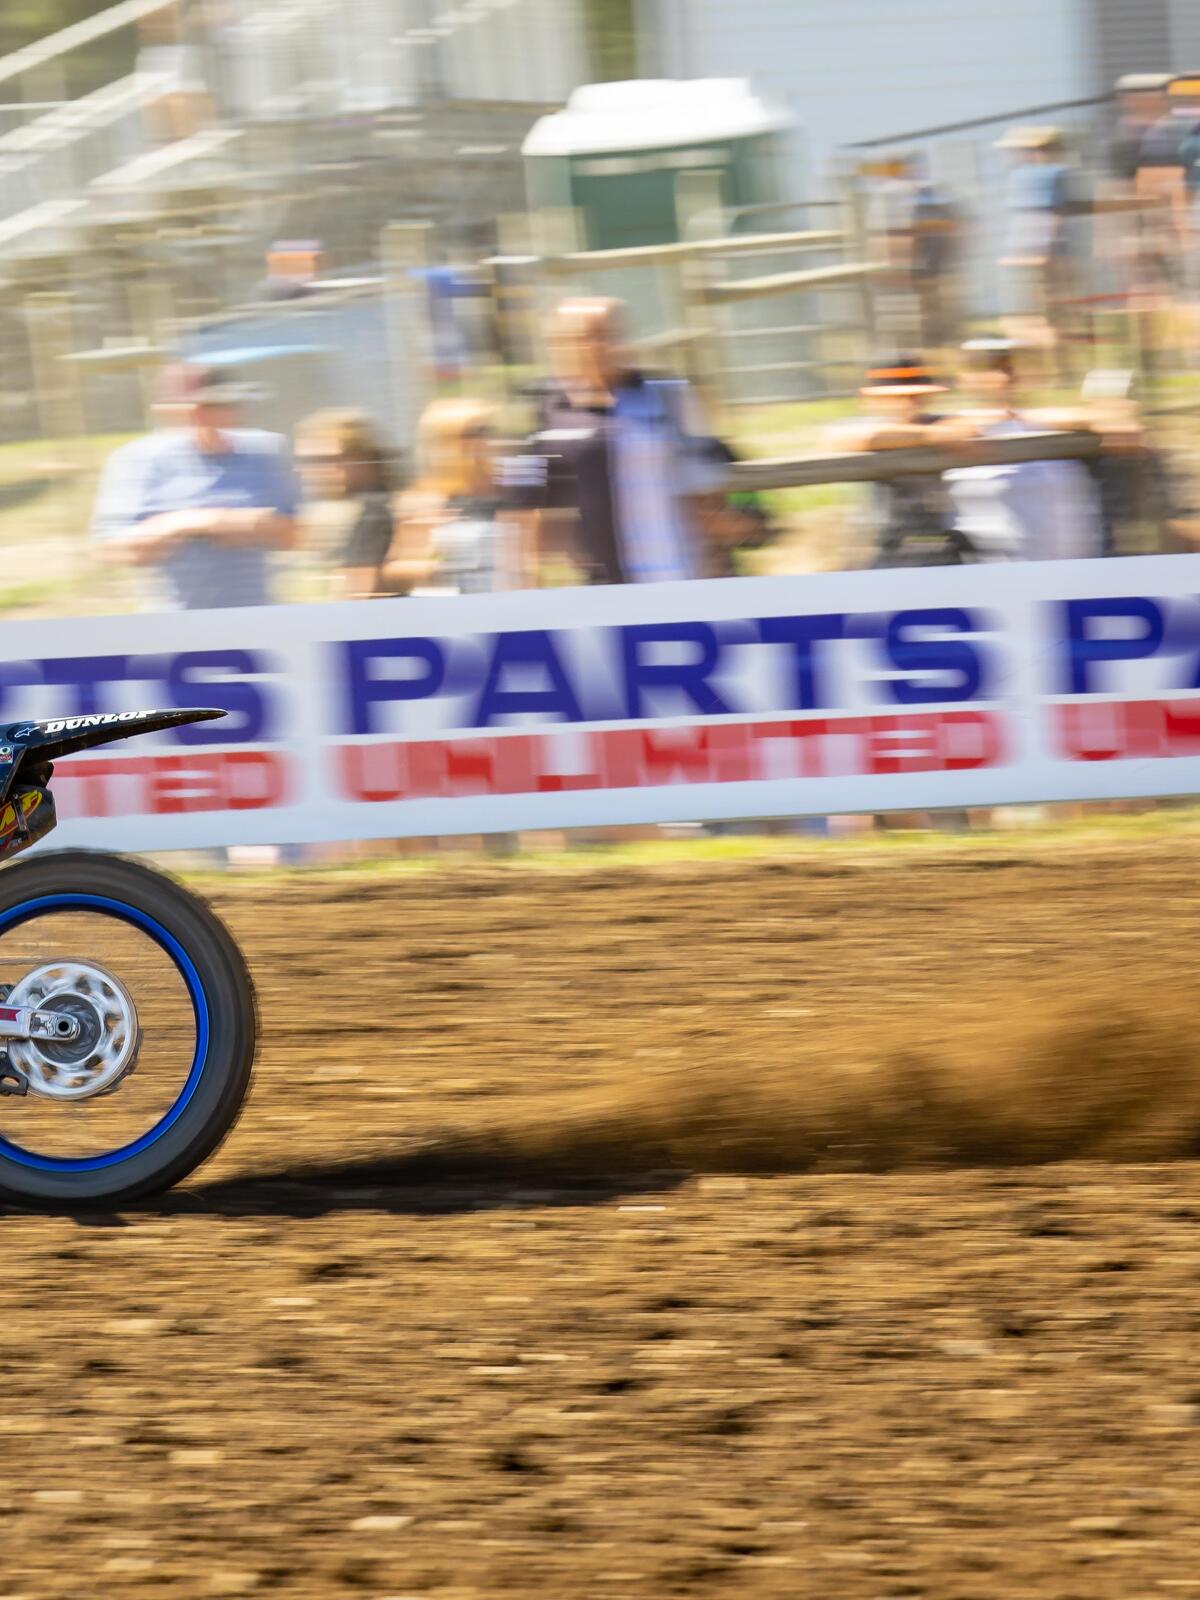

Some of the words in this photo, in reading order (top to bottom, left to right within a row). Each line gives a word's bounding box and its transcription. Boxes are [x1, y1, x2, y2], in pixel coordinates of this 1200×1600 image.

[335, 605, 988, 736] PARTS
[44, 710, 157, 733] DUNLOP
[338, 708, 1005, 801] UNLIMITED
